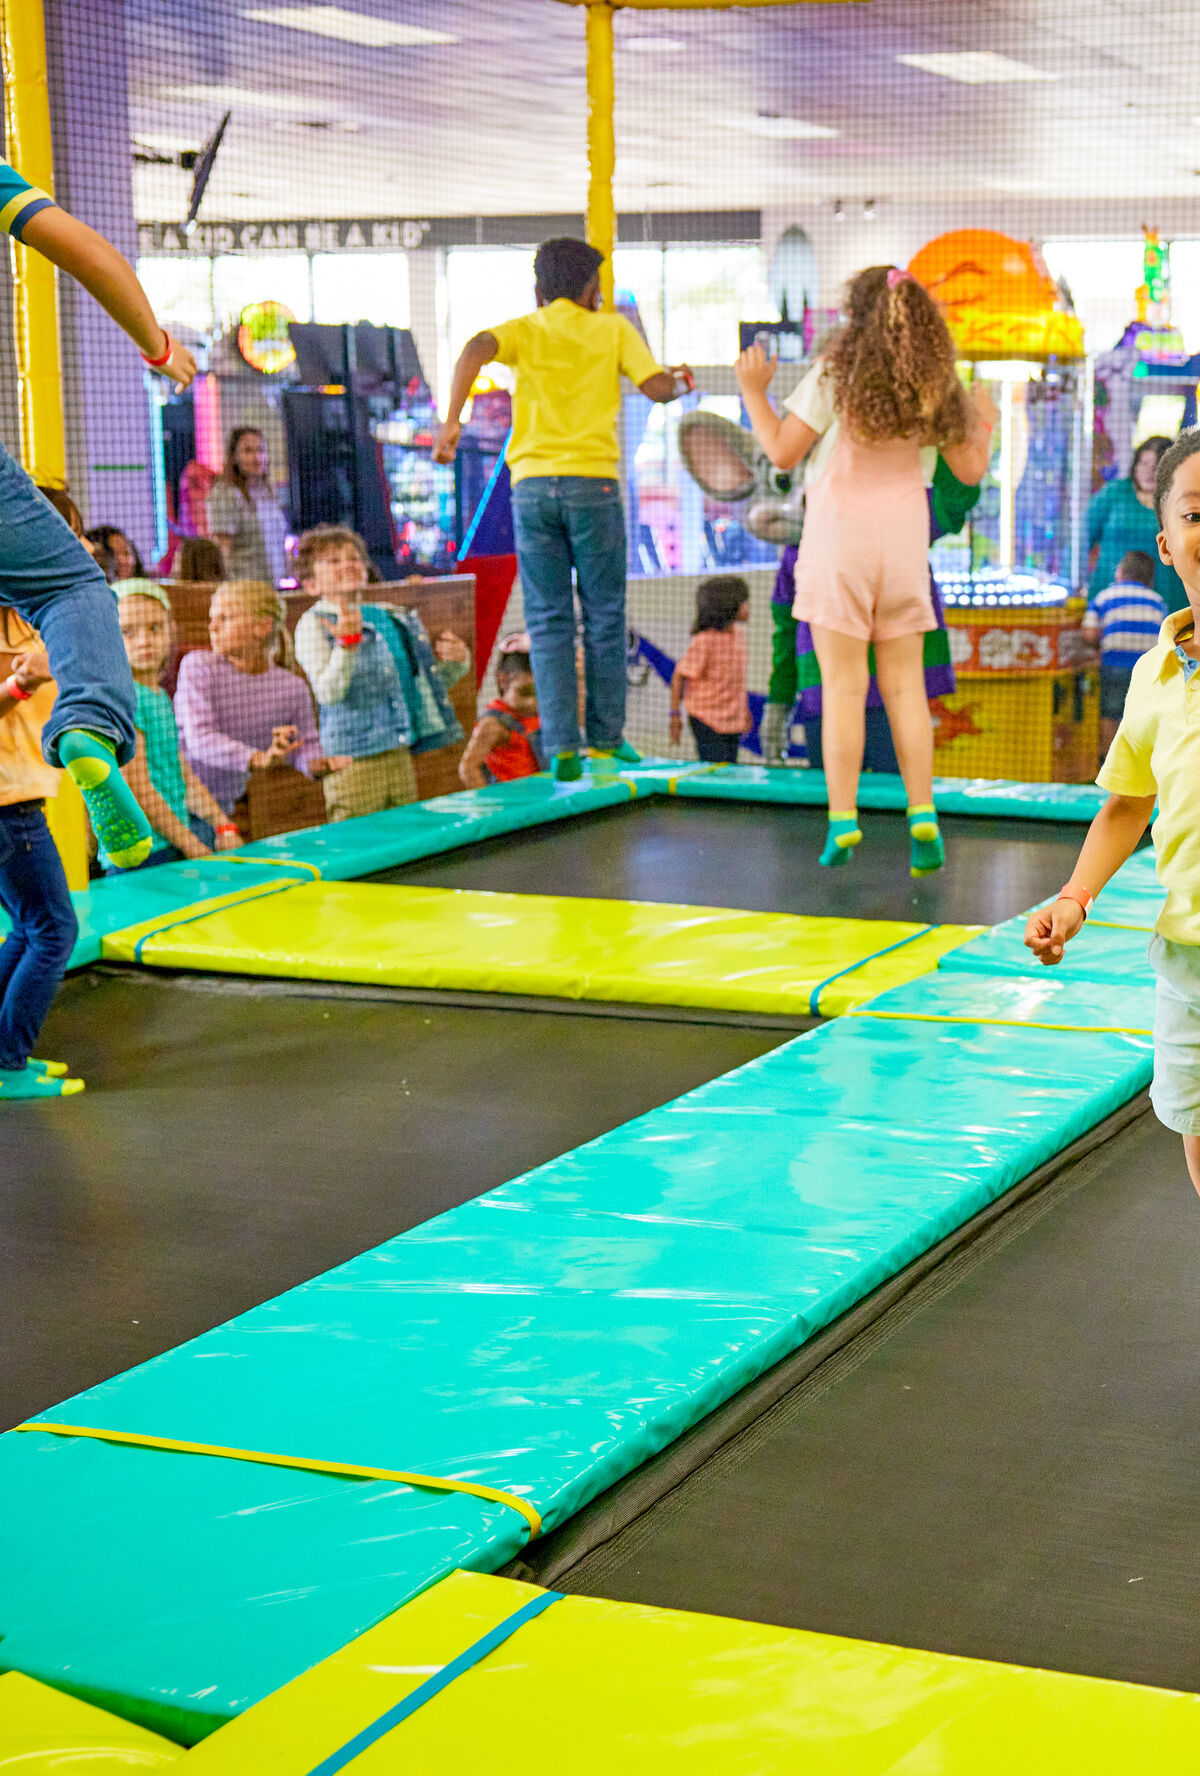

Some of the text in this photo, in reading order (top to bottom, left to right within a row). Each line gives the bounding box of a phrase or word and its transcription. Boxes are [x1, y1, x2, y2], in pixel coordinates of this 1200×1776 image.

[163, 225, 182, 249] A
[240, 224, 299, 249] CAN
[305, 222, 340, 249] BE
[345, 222, 366, 248] A
